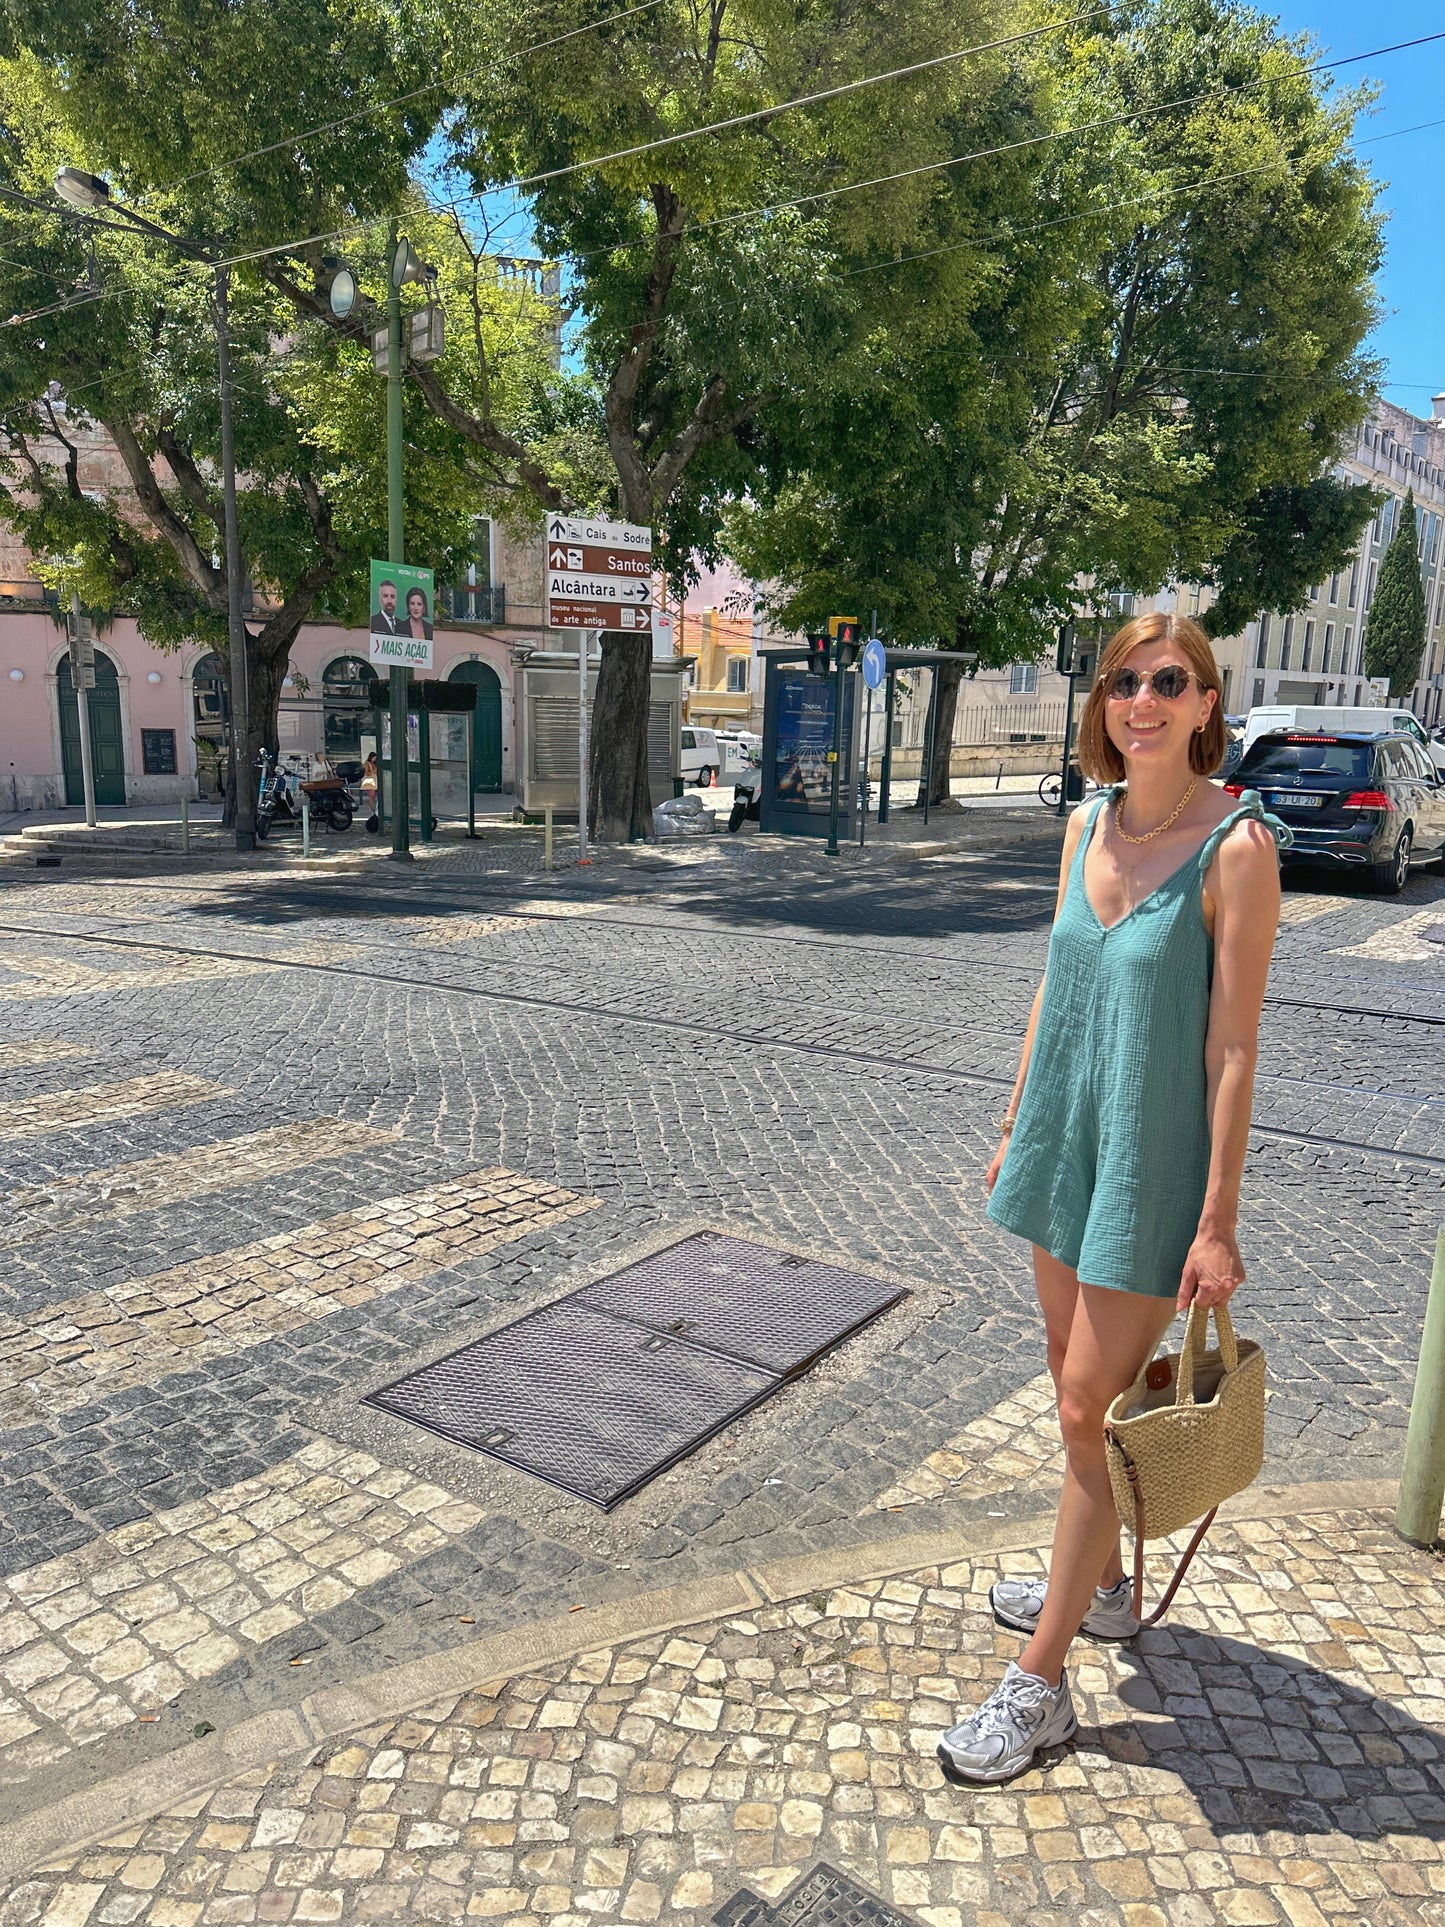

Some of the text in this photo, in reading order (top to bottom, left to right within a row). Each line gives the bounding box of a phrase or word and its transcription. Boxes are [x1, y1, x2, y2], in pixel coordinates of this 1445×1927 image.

[586, 528, 606, 540] Cais
[624, 532, 650, 544] Sodré
[608, 555, 650, 574] Santos
[551, 579, 616, 597] Alcântara
[563, 615, 580, 624] arte
[583, 617, 607, 627] antiga
[381, 640, 403, 656] MAIS
